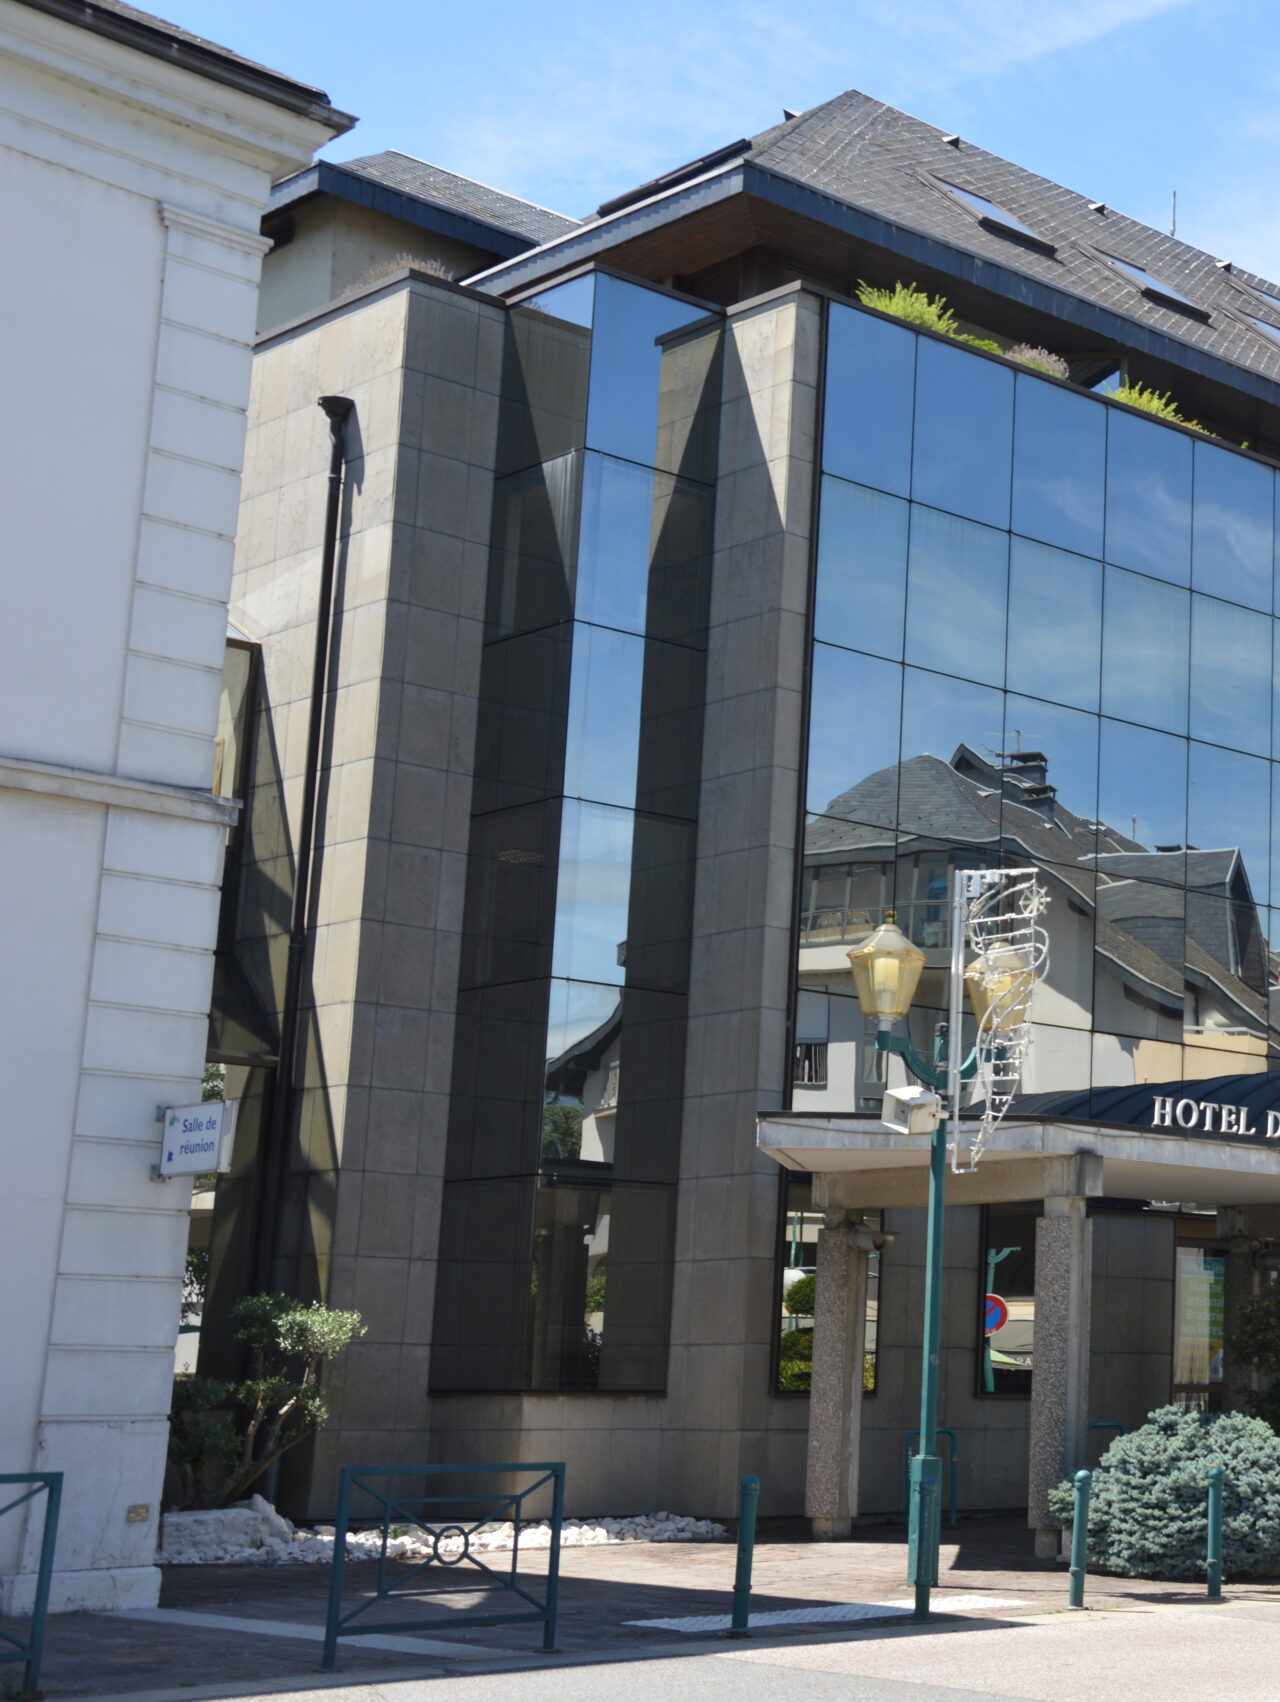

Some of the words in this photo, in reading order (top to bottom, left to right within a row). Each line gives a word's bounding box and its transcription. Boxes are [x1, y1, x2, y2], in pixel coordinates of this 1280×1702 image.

[182, 1117, 203, 1133] Salle
[206, 1116, 217, 1131] de
[1152, 1096, 1256, 1136] HOTEL
[180, 1139, 215, 1155] réunion
